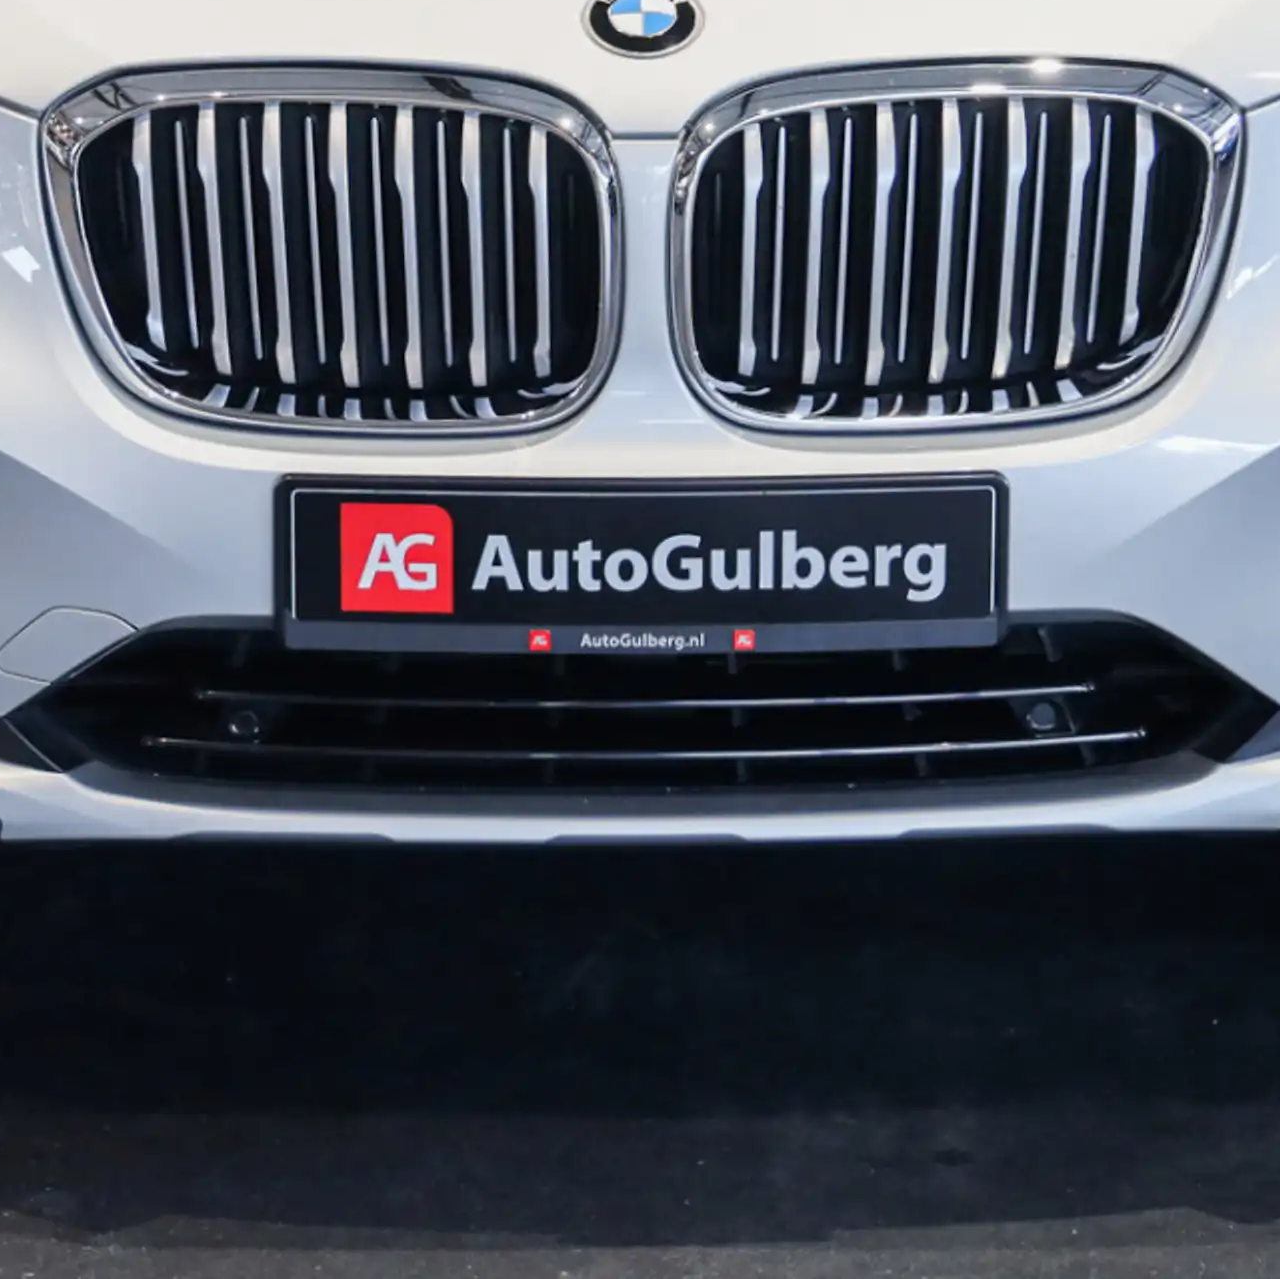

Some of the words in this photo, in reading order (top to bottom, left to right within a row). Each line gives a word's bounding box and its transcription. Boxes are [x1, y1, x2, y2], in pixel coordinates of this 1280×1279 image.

[357, 532, 438, 591] AG
[471, 529, 948, 602] AutoGulberg
[579, 632, 705, 651] AutoGulberg.nl
